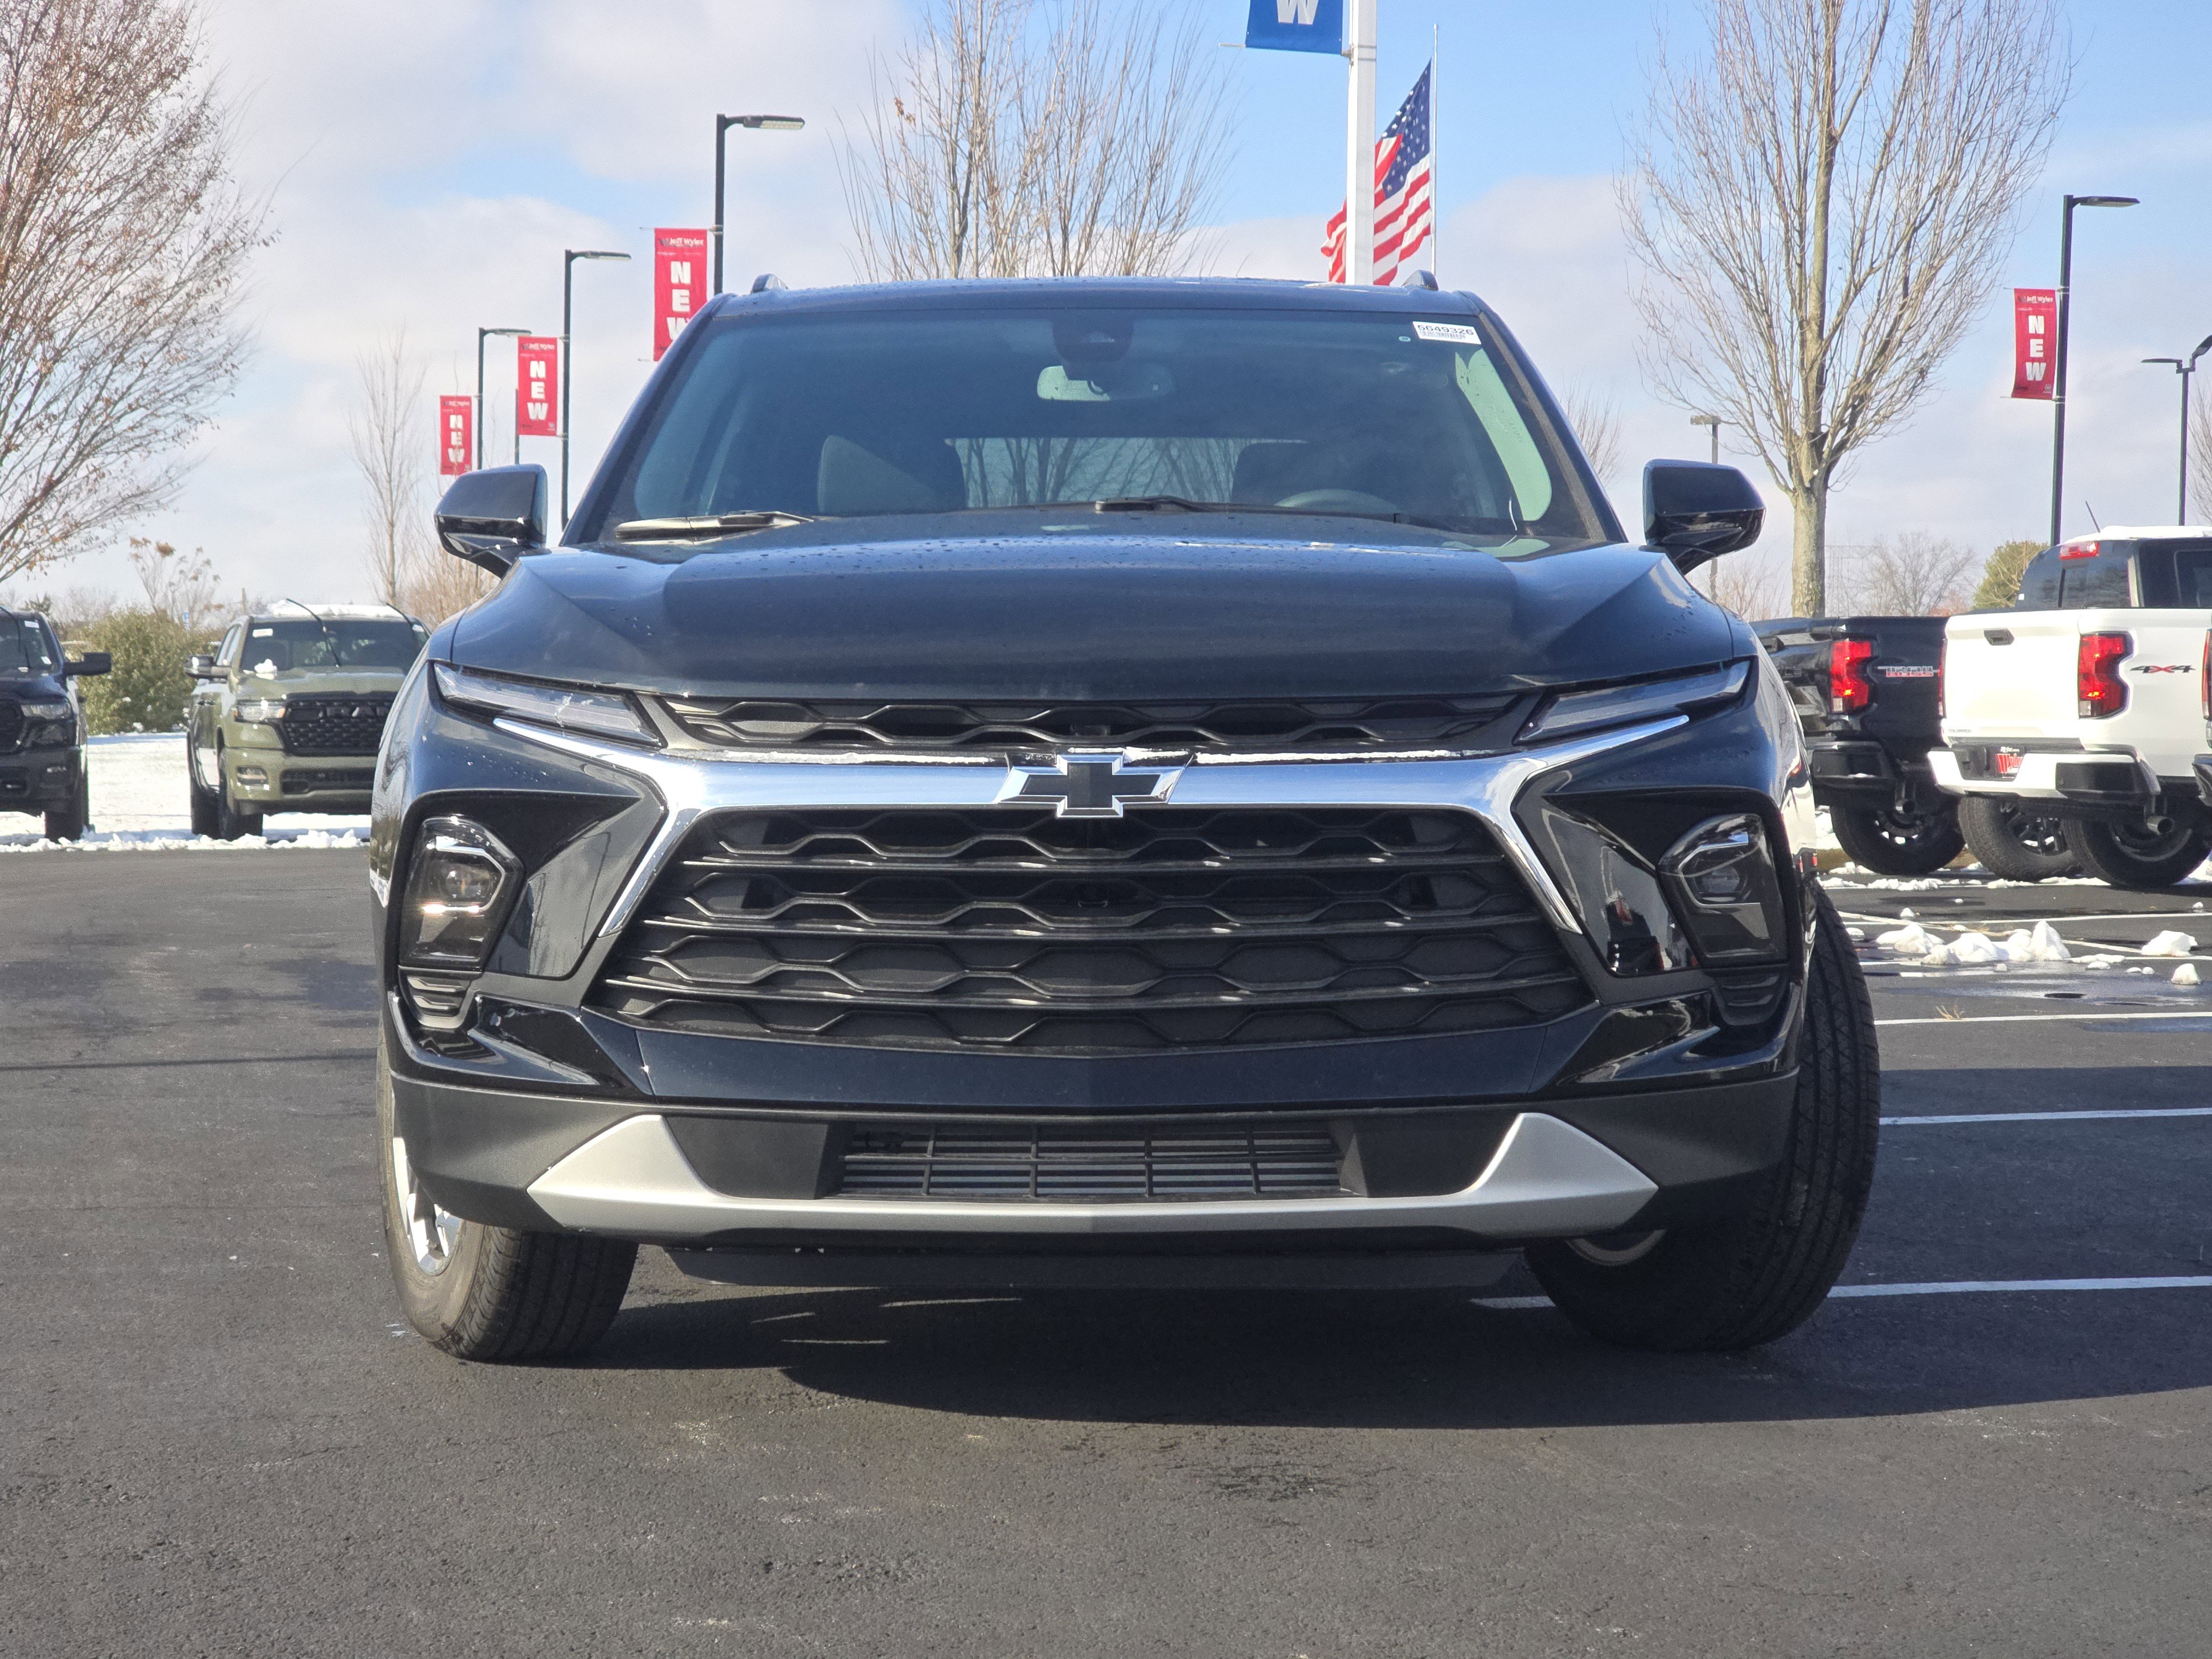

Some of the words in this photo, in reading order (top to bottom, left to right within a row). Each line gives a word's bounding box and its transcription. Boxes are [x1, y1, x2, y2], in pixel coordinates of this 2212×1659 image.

[684, 238, 704, 247] Wyler
[2025, 315, 2047, 381] NEW
[527, 361, 548, 421] NEW
